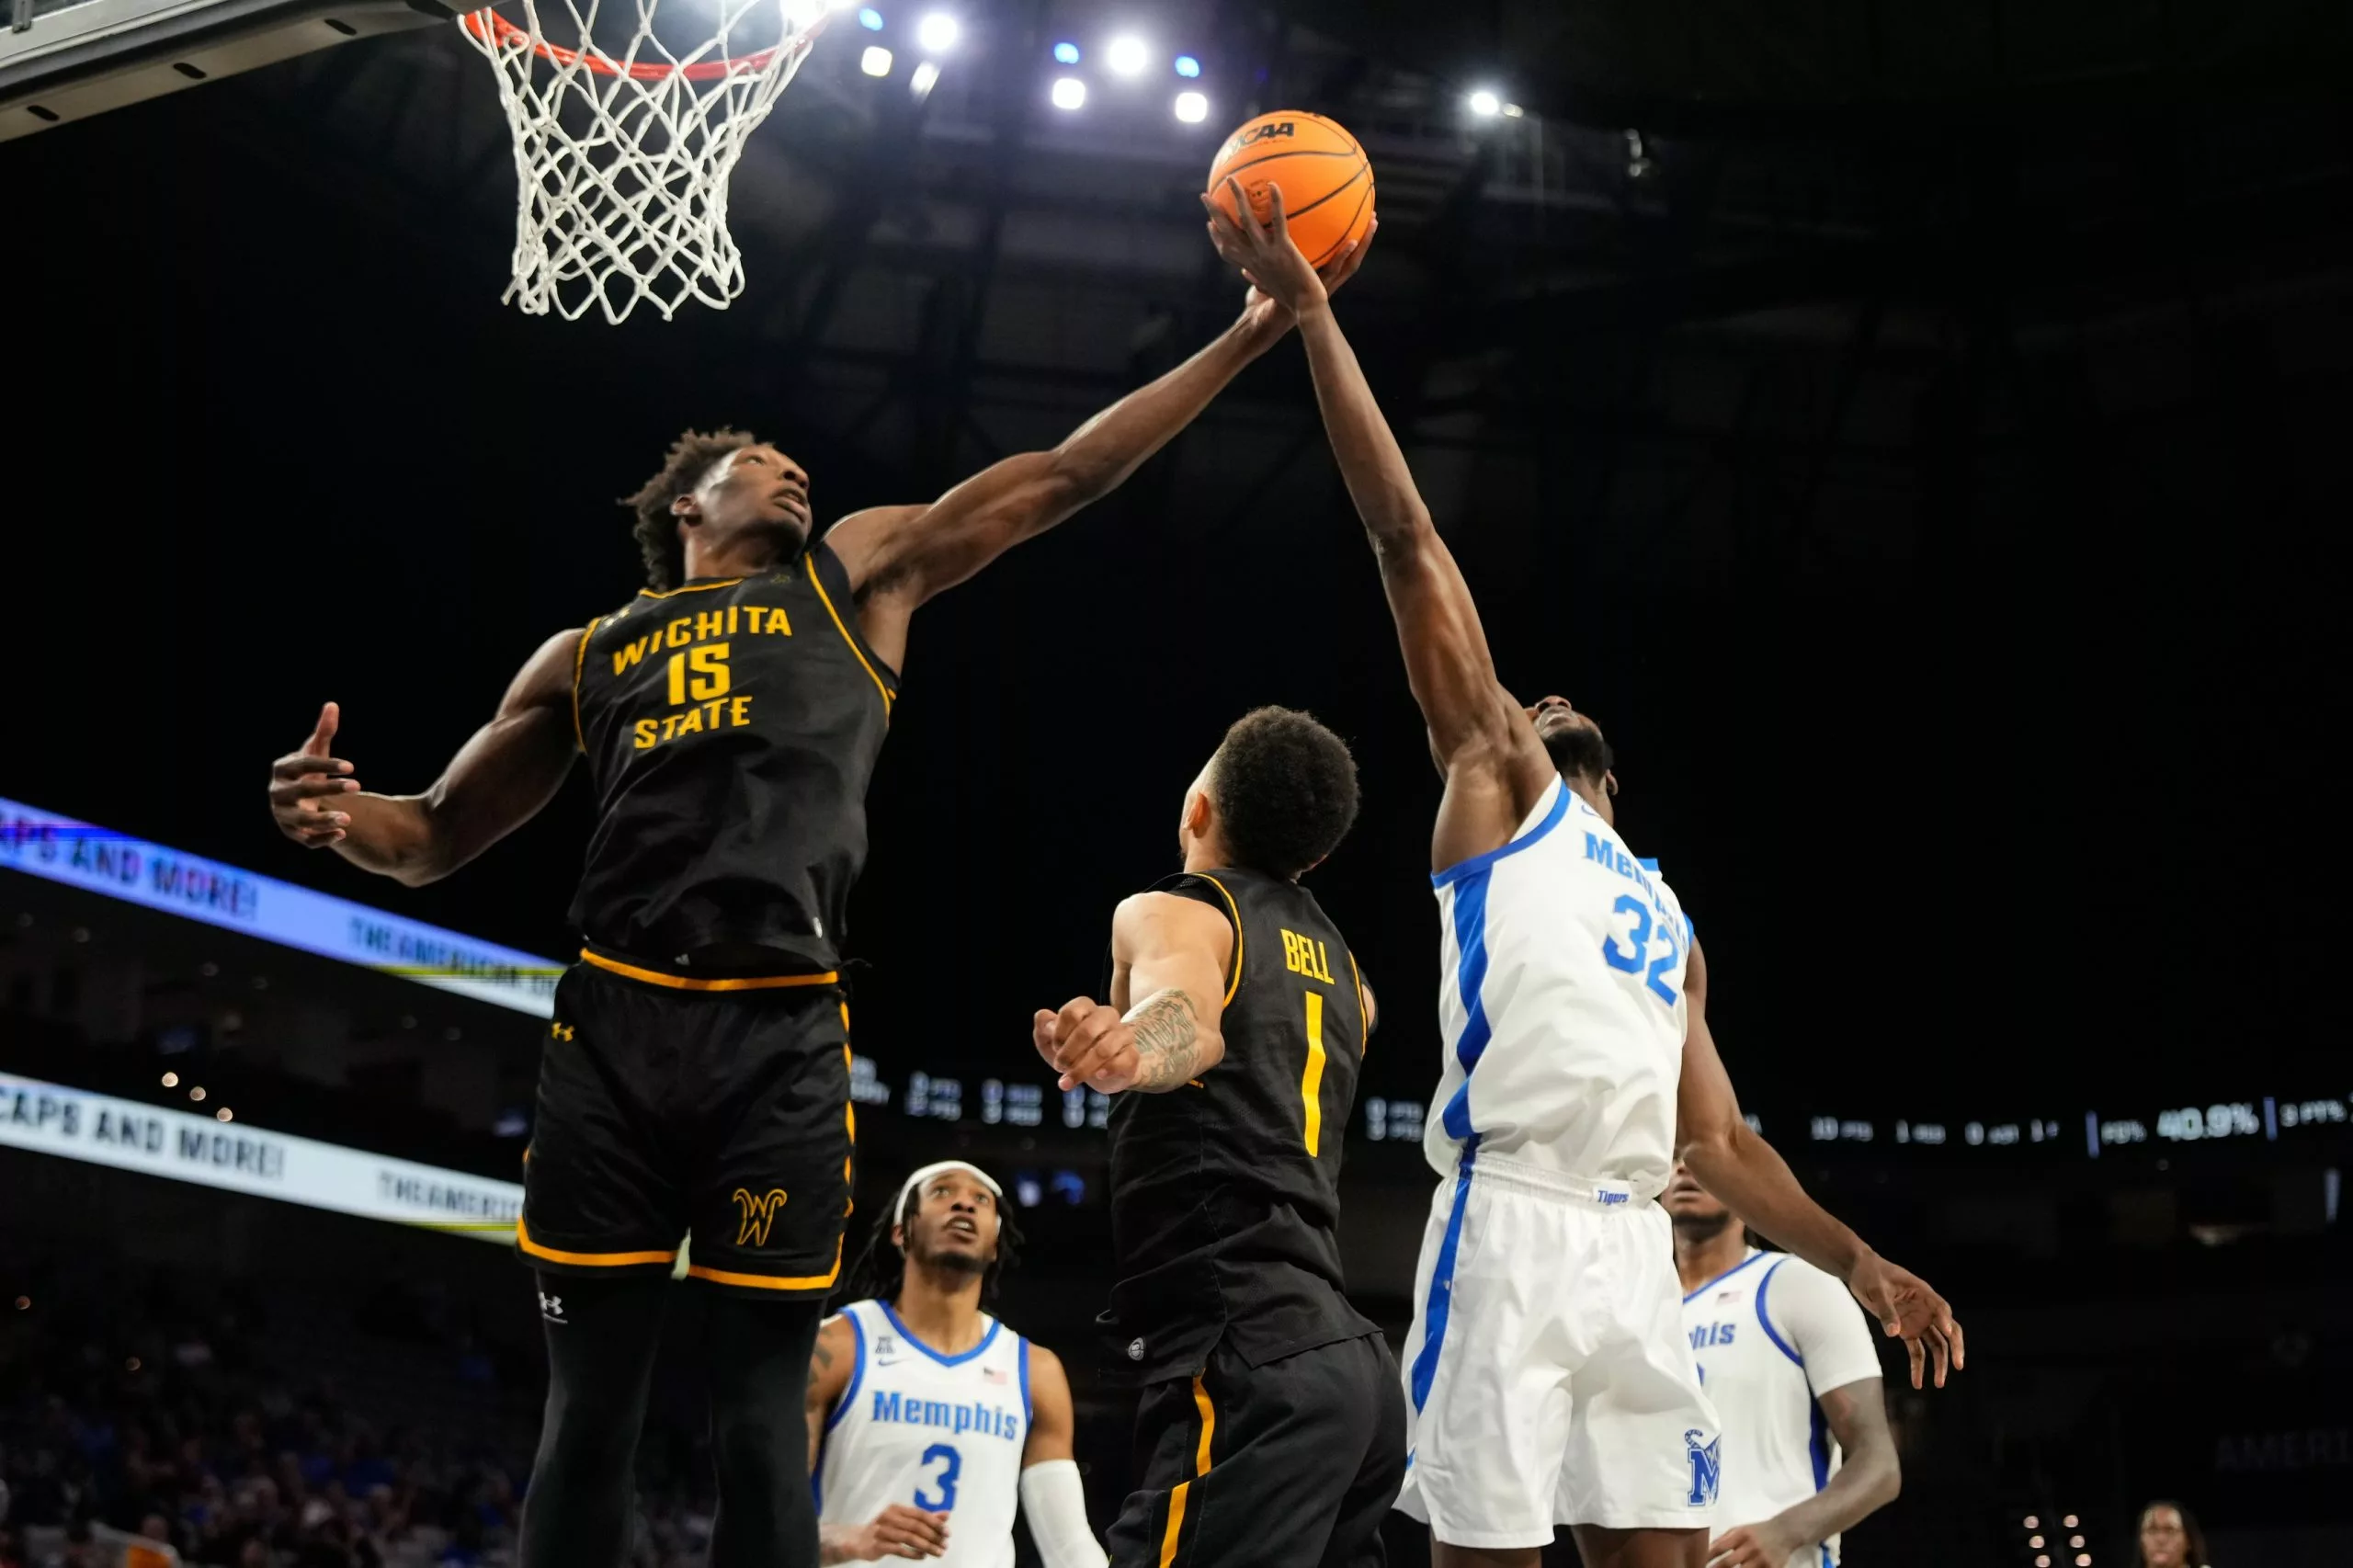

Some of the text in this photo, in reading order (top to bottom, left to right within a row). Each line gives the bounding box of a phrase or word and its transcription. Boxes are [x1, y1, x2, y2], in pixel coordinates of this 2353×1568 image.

[612, 605, 792, 676] WICHITA
[667, 642, 732, 706] 15
[633, 695, 753, 750] STATE
[0, 811, 259, 922] PS AND MORE!
[1279, 928, 1336, 985] BELL
[1602, 893, 1678, 1008] 32
[1302, 991, 1326, 1159] 1
[95, 1108, 165, 1155] AND
[179, 1126, 286, 1180] MORE!
[2156, 1102, 2259, 1142] 40.9%
[1597, 1189, 1630, 1207] Tigers
[1688, 1320, 1736, 1351] his
[871, 1390, 1017, 1441] Memphis
[913, 1442, 962, 1513] 3
